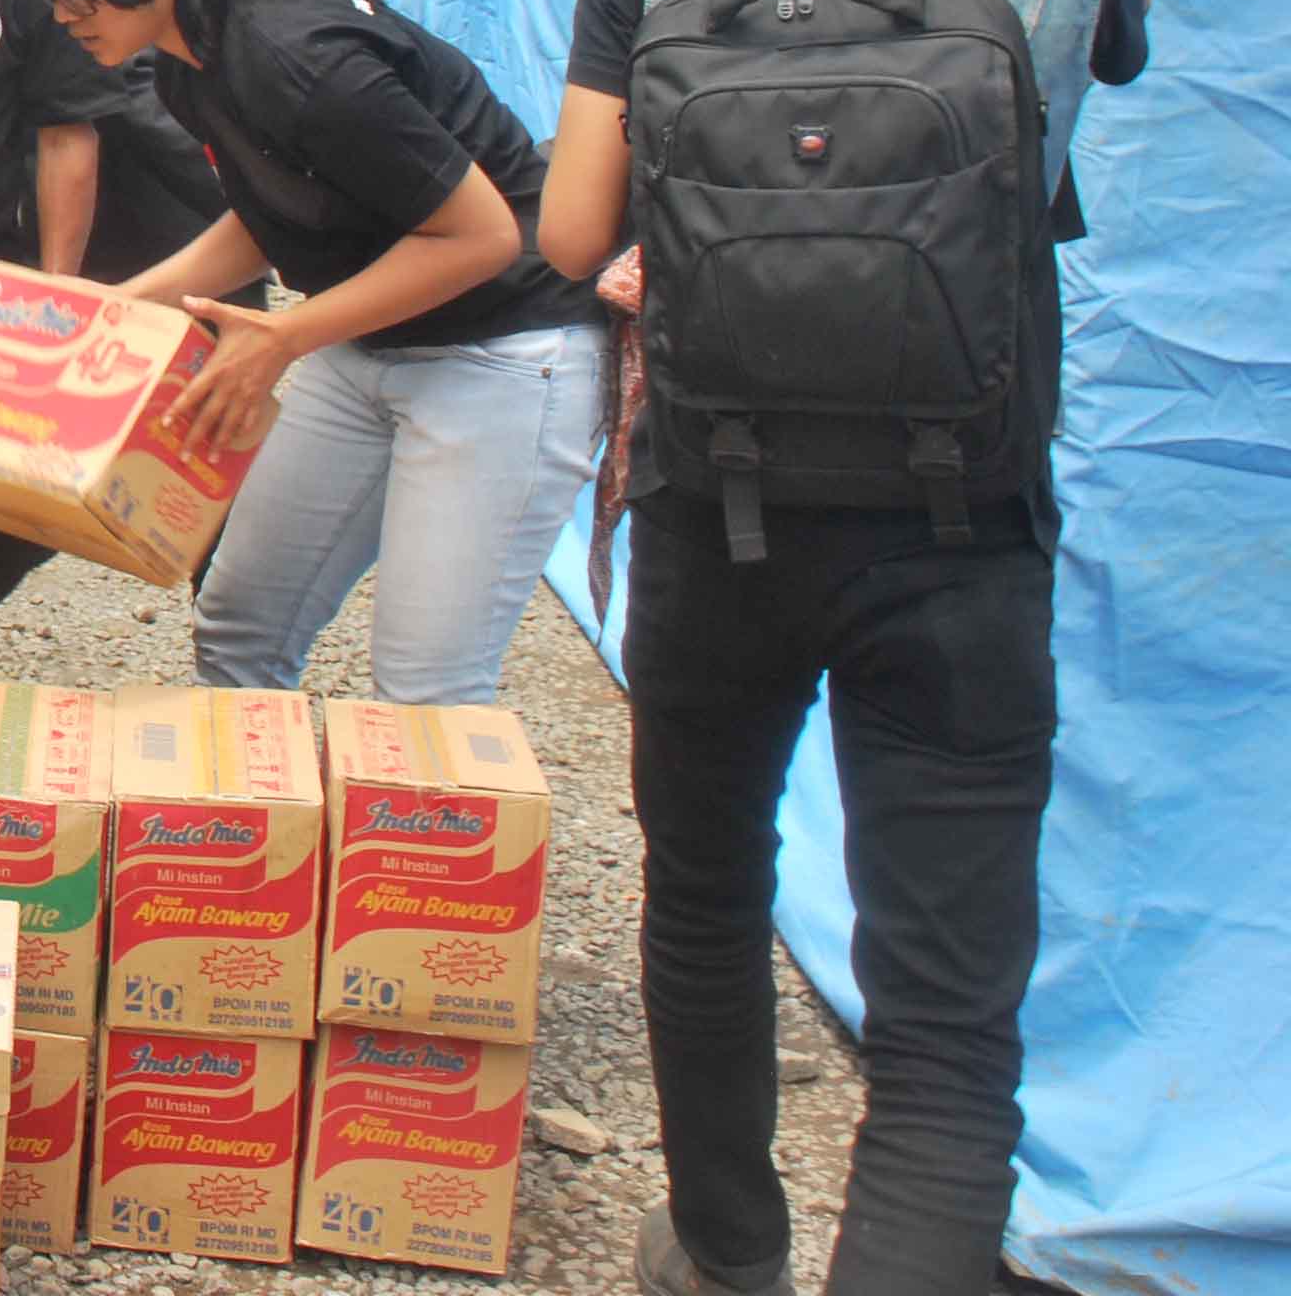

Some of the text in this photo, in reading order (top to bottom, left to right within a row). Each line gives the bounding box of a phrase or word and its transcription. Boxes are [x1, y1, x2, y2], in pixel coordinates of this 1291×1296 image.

[157, 869, 223, 885] Mi Instan
[380, 856, 450, 875] Mi Instan
[132, 901, 290, 932] Ayam Bawang
[354, 890, 516, 927] Ayam Bawang
[145, 1096, 211, 1115] Mi Instan
[385, 1089, 433, 1109] Instan
[122, 1128, 277, 1163] Ayam Bawang
[337, 1120, 497, 1164] Ayam Bawang
